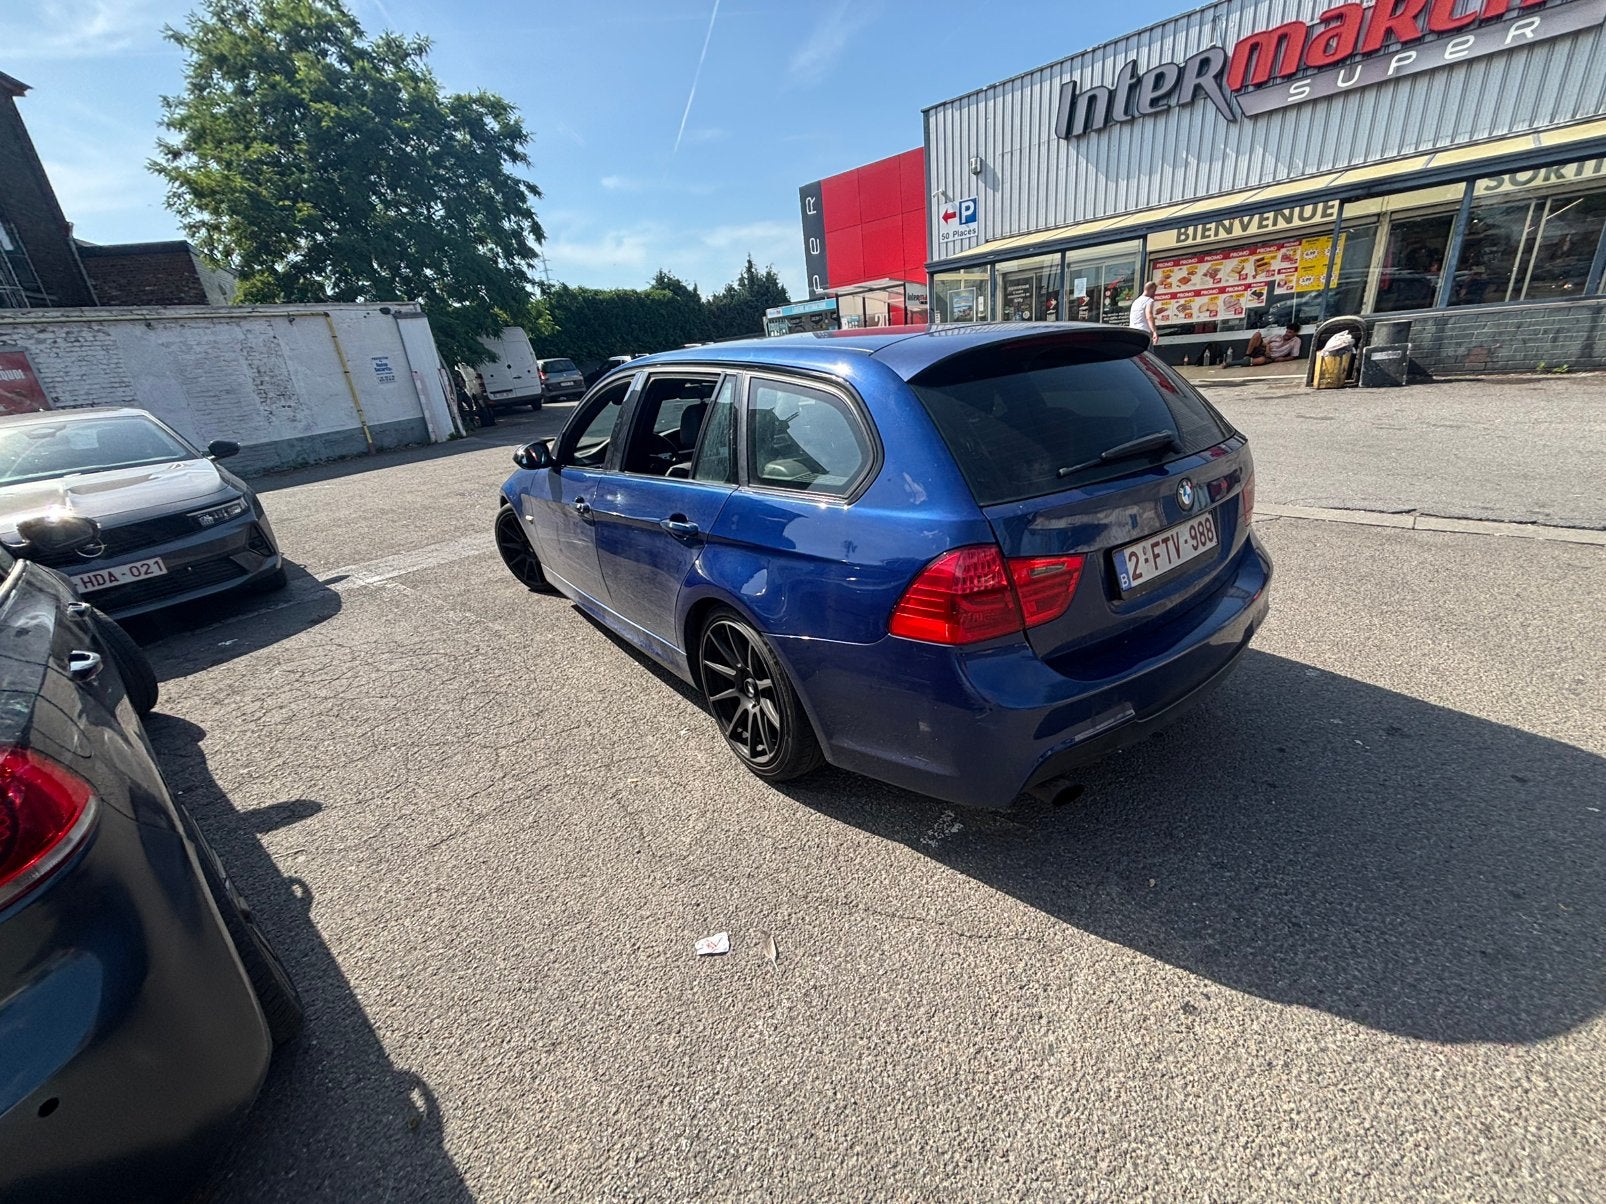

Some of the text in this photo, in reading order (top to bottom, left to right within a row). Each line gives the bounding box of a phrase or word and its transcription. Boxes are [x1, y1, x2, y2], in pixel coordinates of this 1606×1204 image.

[961, 201, 975, 224] P
[1175, 200, 1336, 244] BIENVENUE
[941, 228, 977, 241] 50 Places
[1256, 246, 1278, 254] PROMO
[1200, 288, 1219, 296] PROMO
[1225, 285, 1245, 293] PROMO
[1128, 517, 1214, 582] 2-FTV-988
[75, 560, 163, 589] -HDA-021
[1120, 573, 1129, 587] B
